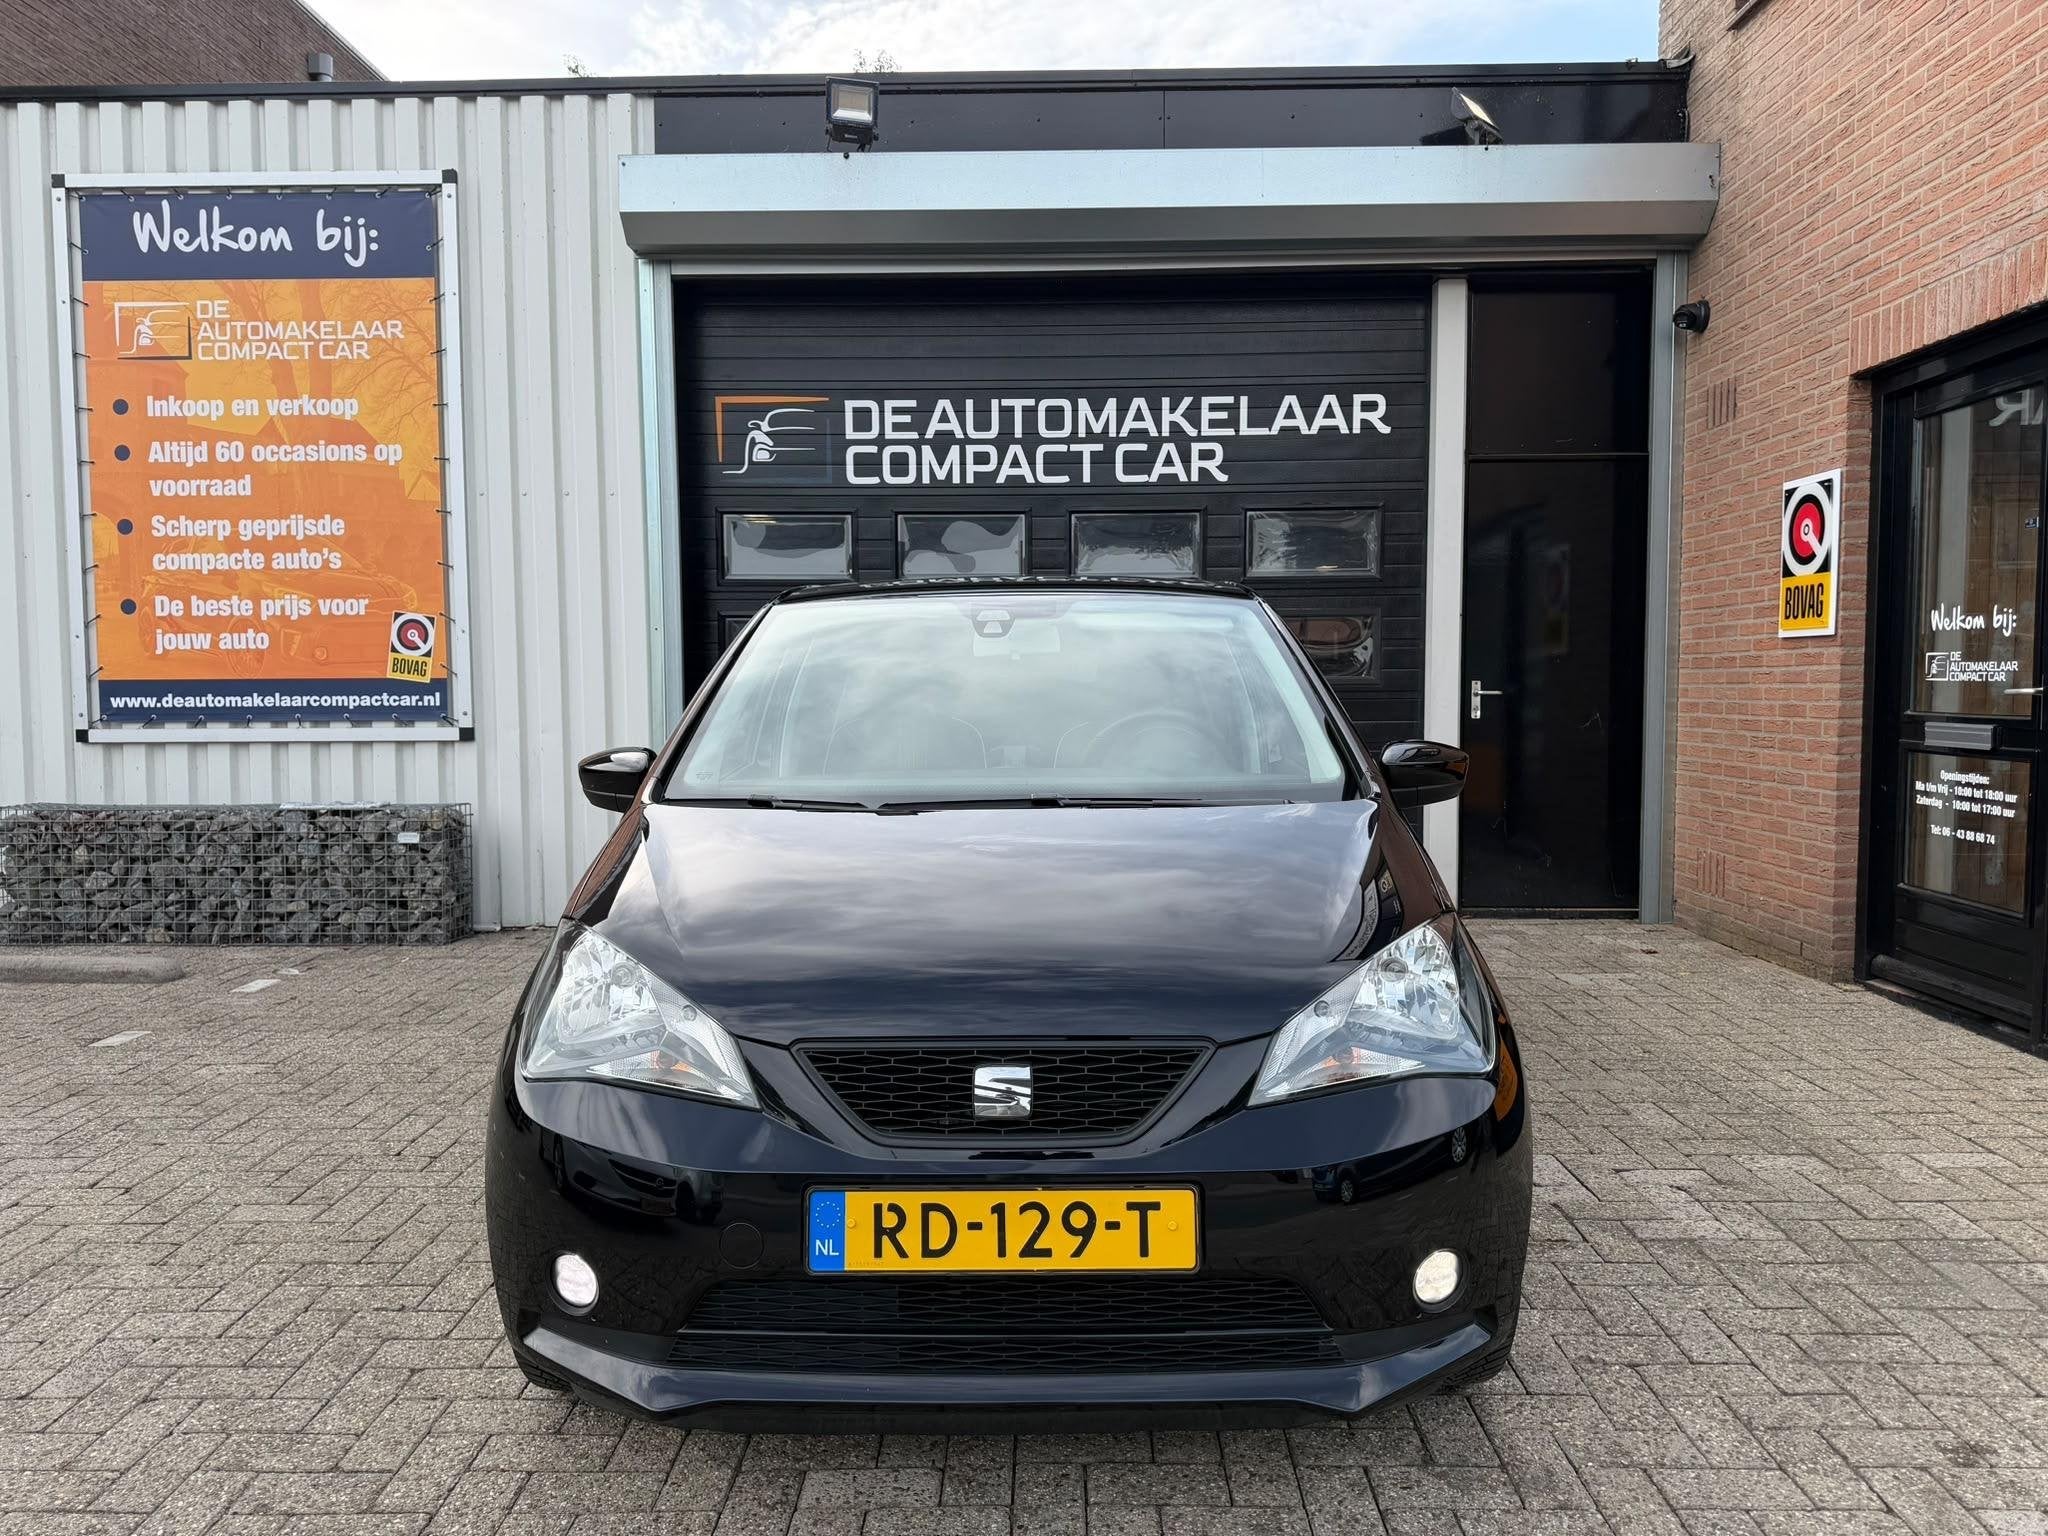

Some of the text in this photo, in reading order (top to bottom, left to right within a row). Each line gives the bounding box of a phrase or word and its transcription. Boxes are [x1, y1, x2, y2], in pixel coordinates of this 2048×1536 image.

[133, 200, 379, 268] Welkom bij:
[197, 300, 230, 319] DE
[197, 320, 405, 341] AUTOMAKELAAR
[198, 341, 370, 361] COMPACT CAR
[147, 395, 359, 421] Inkoop en verkoop
[844, 393, 1392, 441] DE AUTOMAKELAAR
[148, 441, 403, 468] Altijd 60 occasions op
[845, 441, 1229, 485] COMPACT CAR
[149, 475, 251, 497] voorraad
[151, 514, 346, 541] Scherp geprijsde
[152, 548, 342, 574] compacte auto's
[155, 595, 369, 621] De beste prijs voor
[1784, 582, 1824, 620] BOVAG
[1930, 602, 2017, 637] Welkom bij:
[155, 629, 270, 655] jouw auto
[391, 657, 428, 677] BOVAG
[1949, 661, 2018, 671] AUTOMAKELAAR
[1950, 651, 1962, 661] DE
[1949, 672, 2006, 682] COMPACT CAR
[110, 691, 441, 710] www.deautomakelaarcompactcar.nl
[1940, 769, 1990, 785] Openingstijden:
[1915, 781, 1925, 791] Ma
[1973, 788, 1983, 799] tot
[2005, 794, 2018, 803] uur
[1916, 795, 1943, 809] Zaterdag
[1971, 802, 1981, 813] tot
[1983, 804, 2001, 816] 17:00
[2002, 808, 2016, 818] uur
[1956, 829, 1965, 840] 43
[1986, 834, 1995, 845] 74
[873, 1200, 1161, 1259] RD-129-T
[815, 1239, 839, 1256] NL
